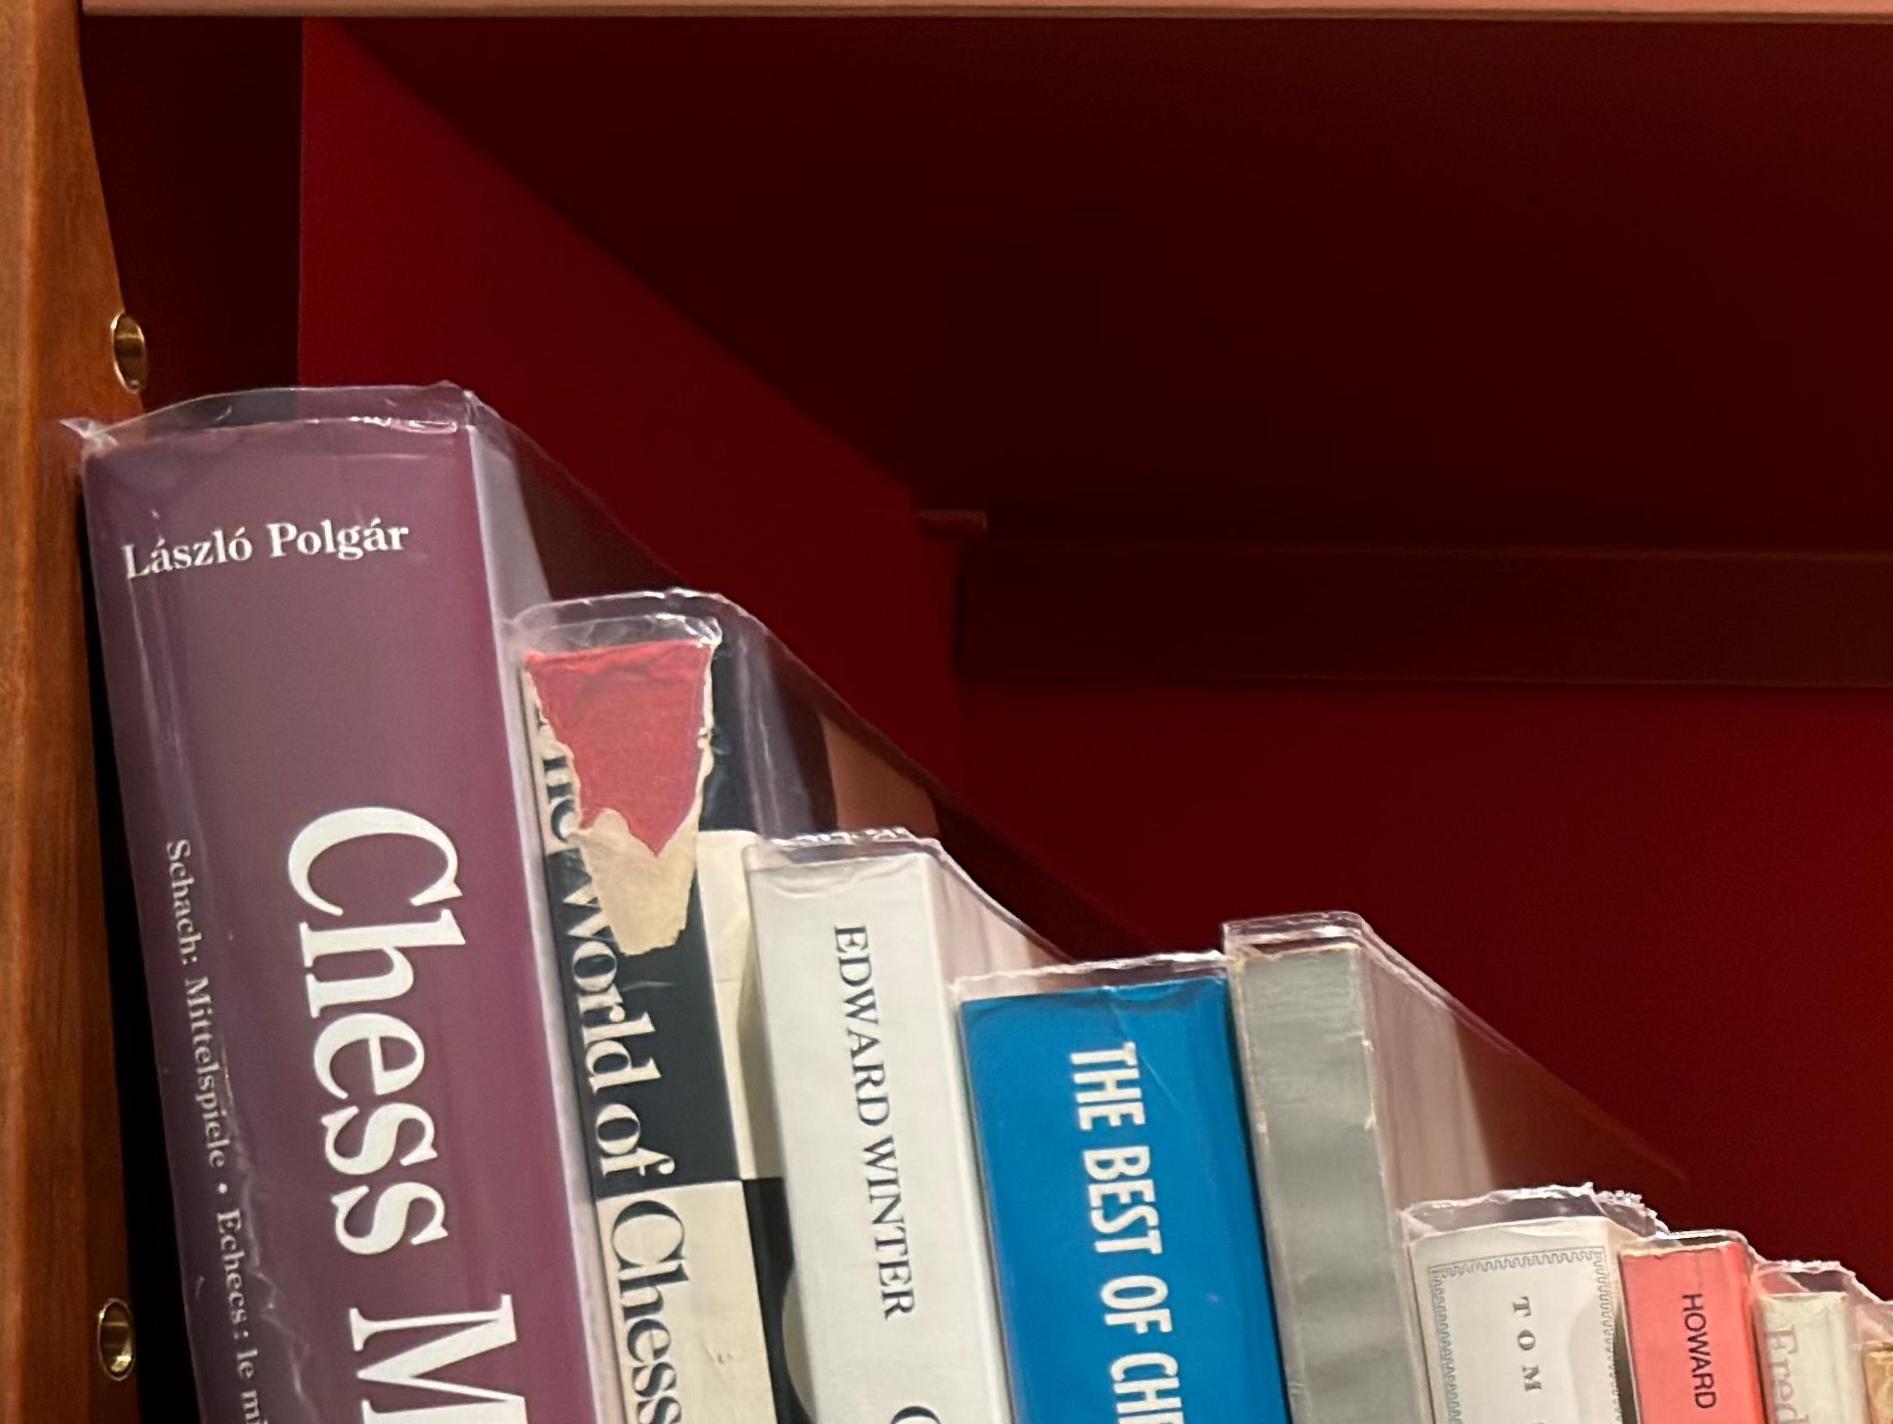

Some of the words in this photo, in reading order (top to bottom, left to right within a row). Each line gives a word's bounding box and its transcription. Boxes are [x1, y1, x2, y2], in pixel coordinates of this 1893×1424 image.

[122, 527, 253, 580] László
[268, 517, 410, 563] Polgár
[288, 807, 465, 1255] Chess
[834, 924, 896, 1127] EDWARD
[165, 839, 202, 966] Schach:
[185, 976, 226, 1169] Mittelspiele
[237, 1348, 259, 1379] le
[1070, 1041, 1147, 1131] THE
[596, 1104, 676, 1178] of
[862, 1136, 916, 1320] WINTER
[1083, 1146, 1163, 1254] BEST
[1100, 1275, 1173, 1334] OF
[1513, 1296, 1543, 1393] TOM
[1682, 1293, 1717, 1410] HOWARD
